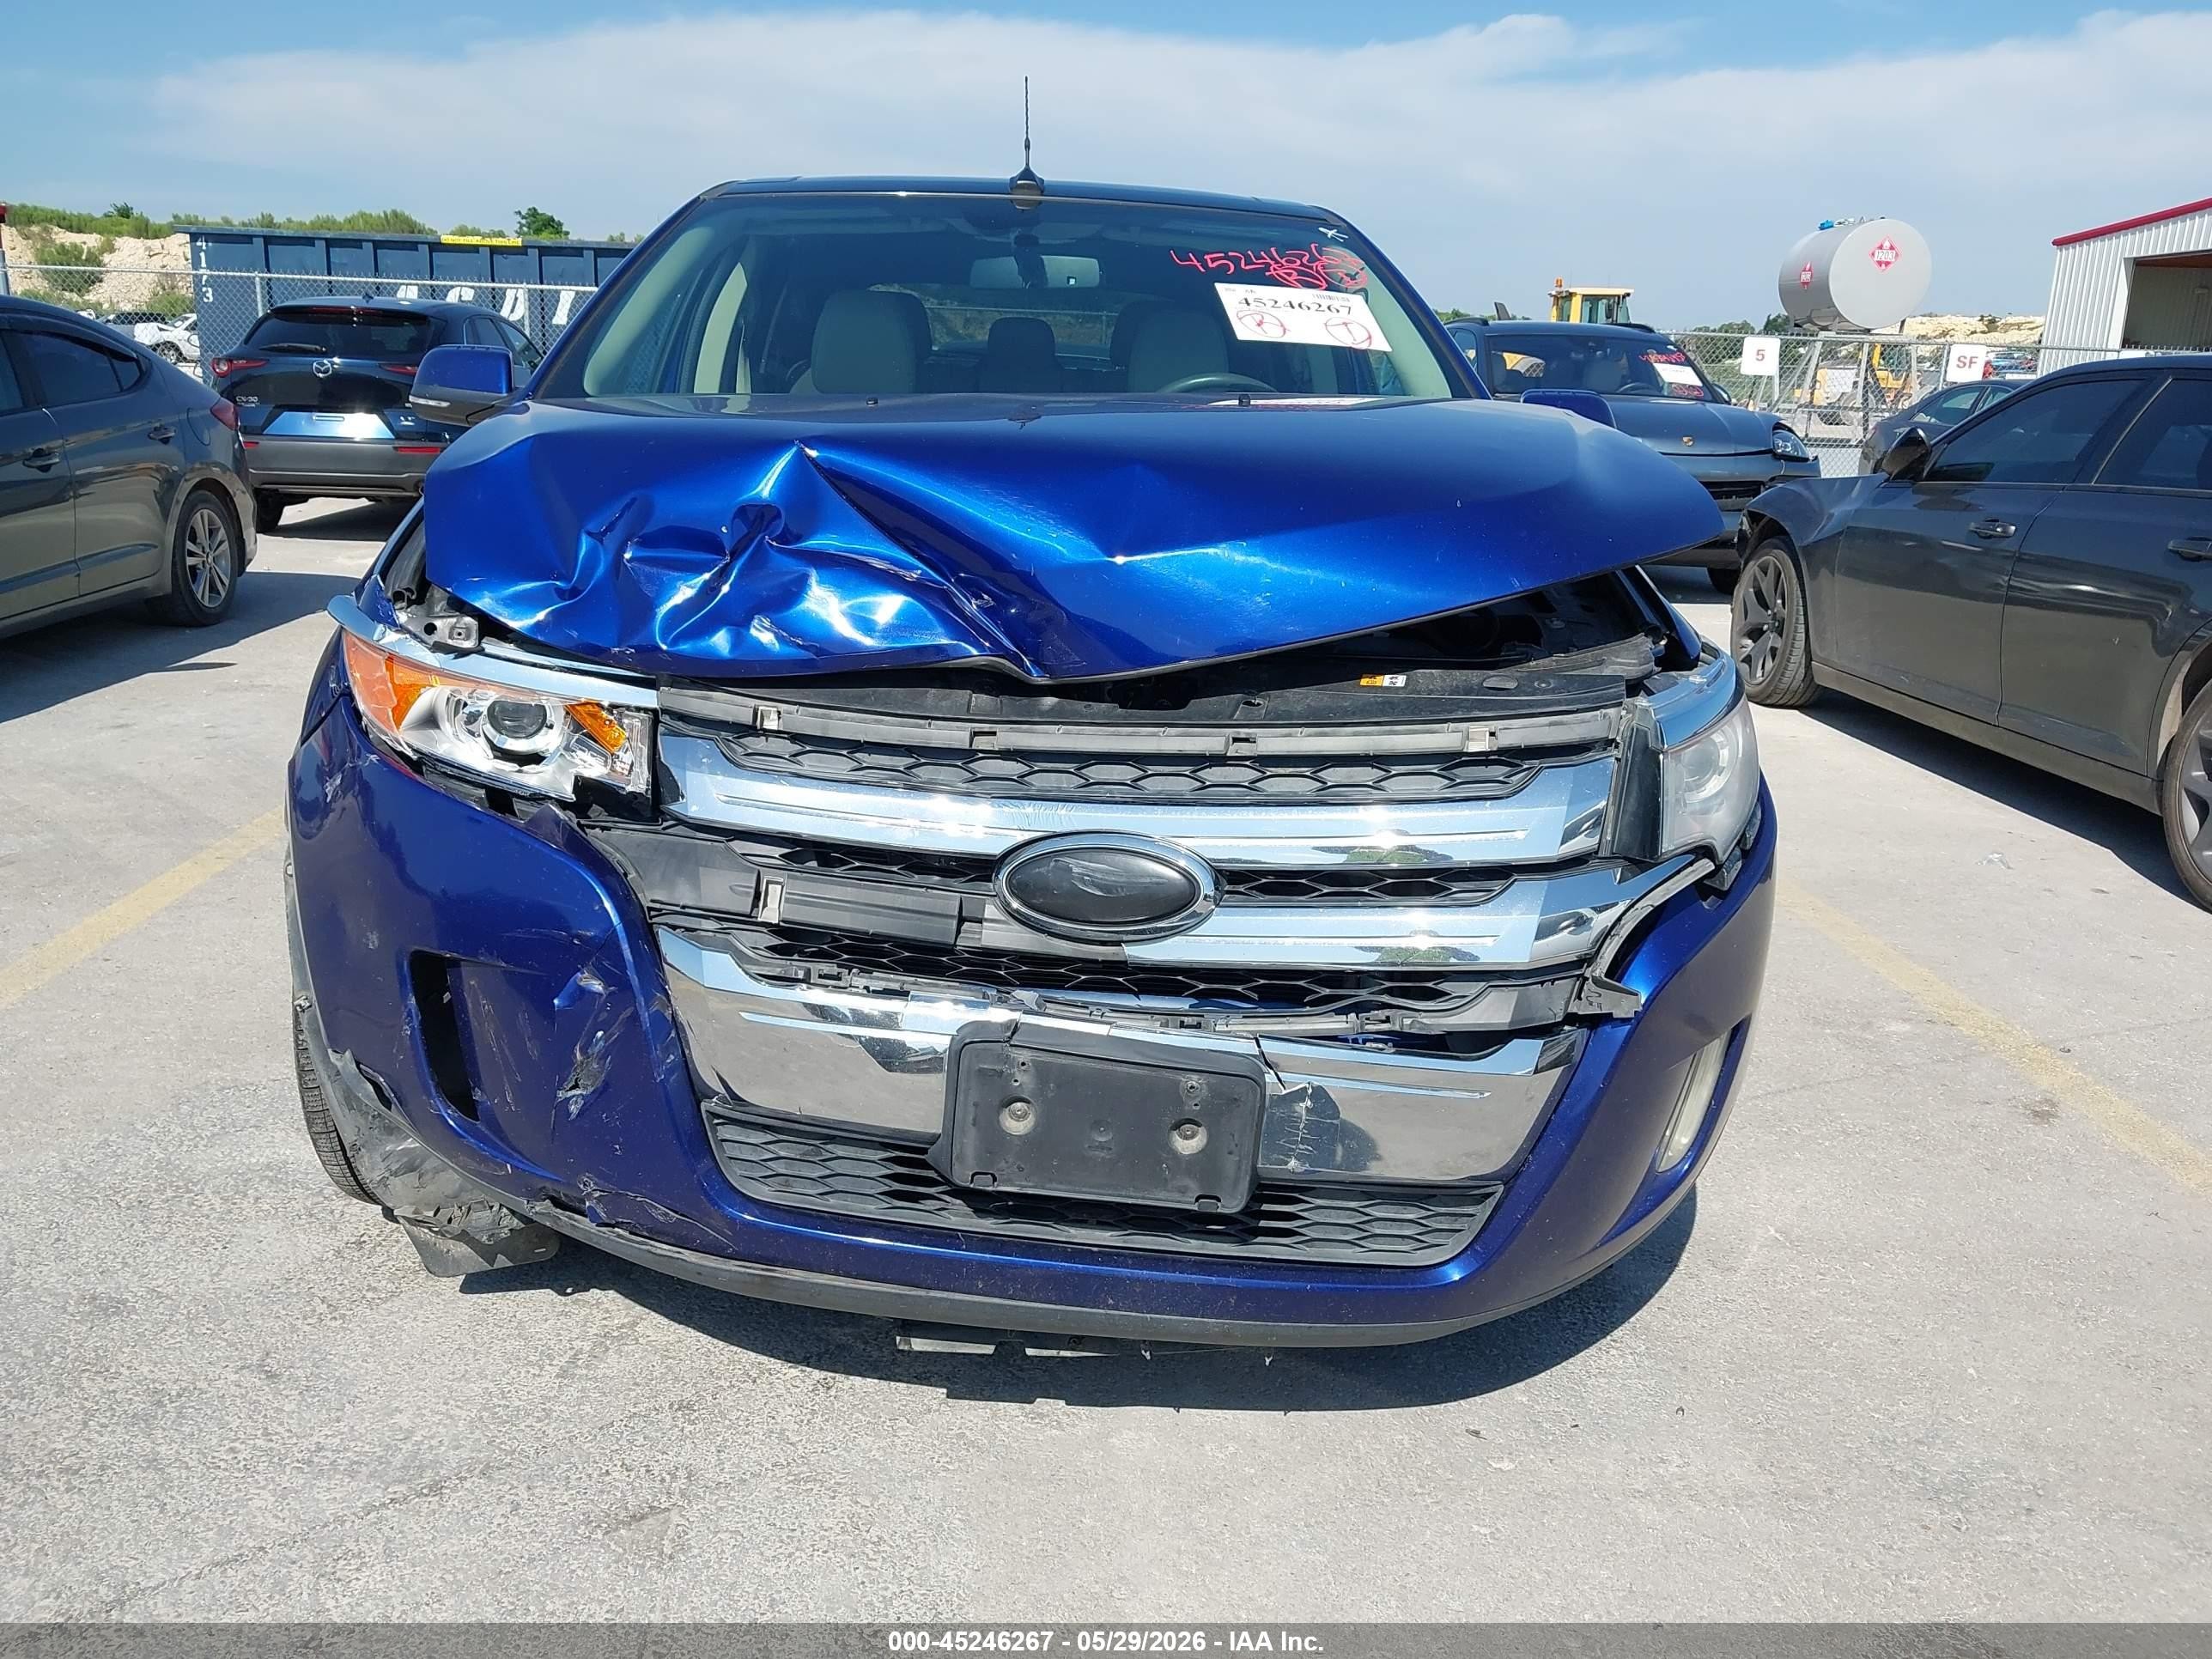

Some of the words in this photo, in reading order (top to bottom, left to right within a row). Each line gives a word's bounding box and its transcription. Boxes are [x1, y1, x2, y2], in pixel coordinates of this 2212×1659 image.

[1877, 251, 1894, 260] 1203
[1238, 297, 1352, 315] 45246267
[1755, 349, 1765, 362] 5
[1955, 356, 1978, 369] SF
